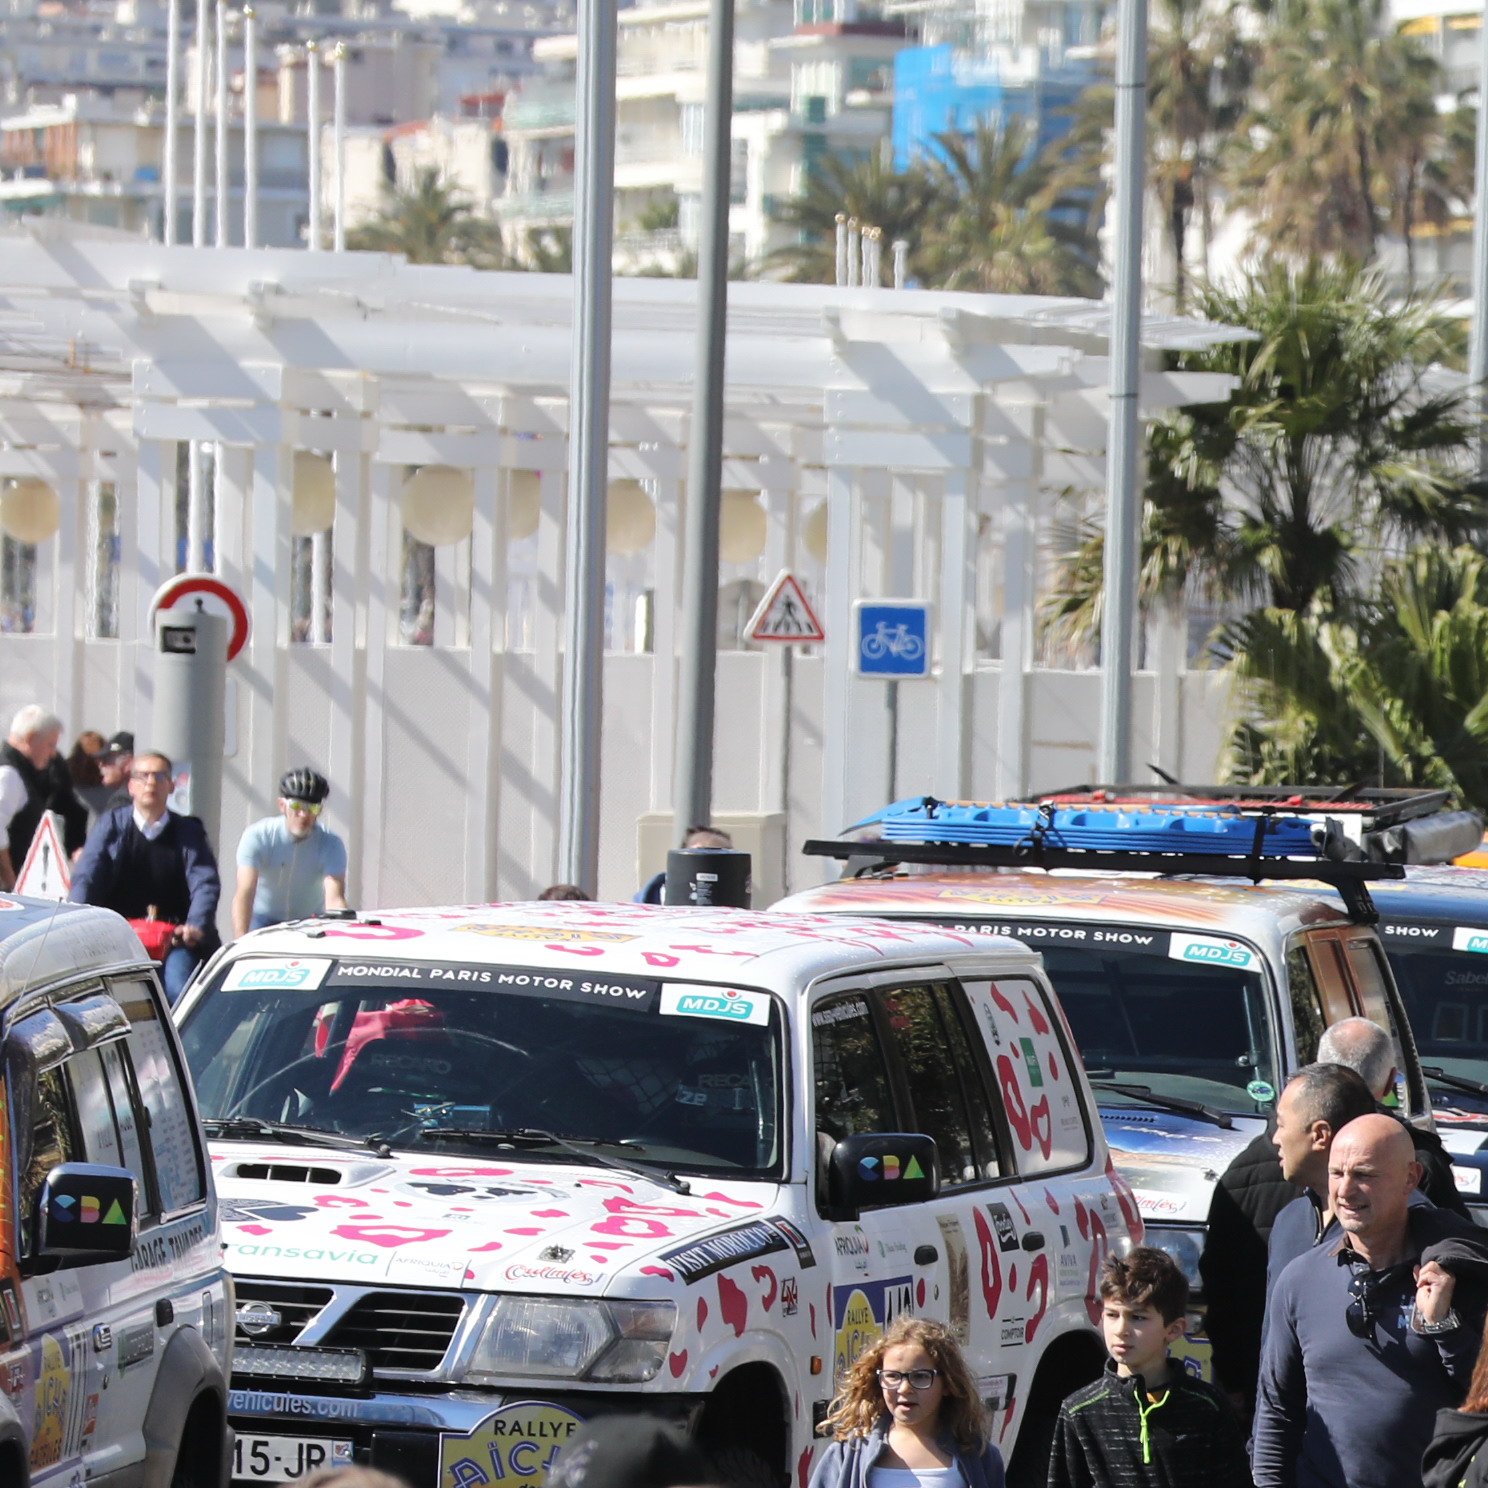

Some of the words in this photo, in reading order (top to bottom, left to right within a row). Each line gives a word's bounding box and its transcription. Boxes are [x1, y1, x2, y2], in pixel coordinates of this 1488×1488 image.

[1017, 925, 1087, 940] MOTOR
[1093, 930, 1154, 946] SHOW
[1384, 924, 1440, 938] SHOW
[1189, 944, 1248, 963] MDJS
[245, 968, 305, 984] MDJS
[337, 965, 422, 980] MONDIAL
[429, 968, 492, 984] PARIS
[497, 973, 575, 992] MOTOR
[580, 981, 648, 1001] SHOW
[682, 997, 749, 1016] MDJS
[857, 1153, 926, 1182] CBA
[52, 1194, 128, 1226] CBA
[227, 1243, 381, 1266] ransavia
[665, 1246, 715, 1277] VISIT
[702, 1226, 774, 1262] MOROCCO
